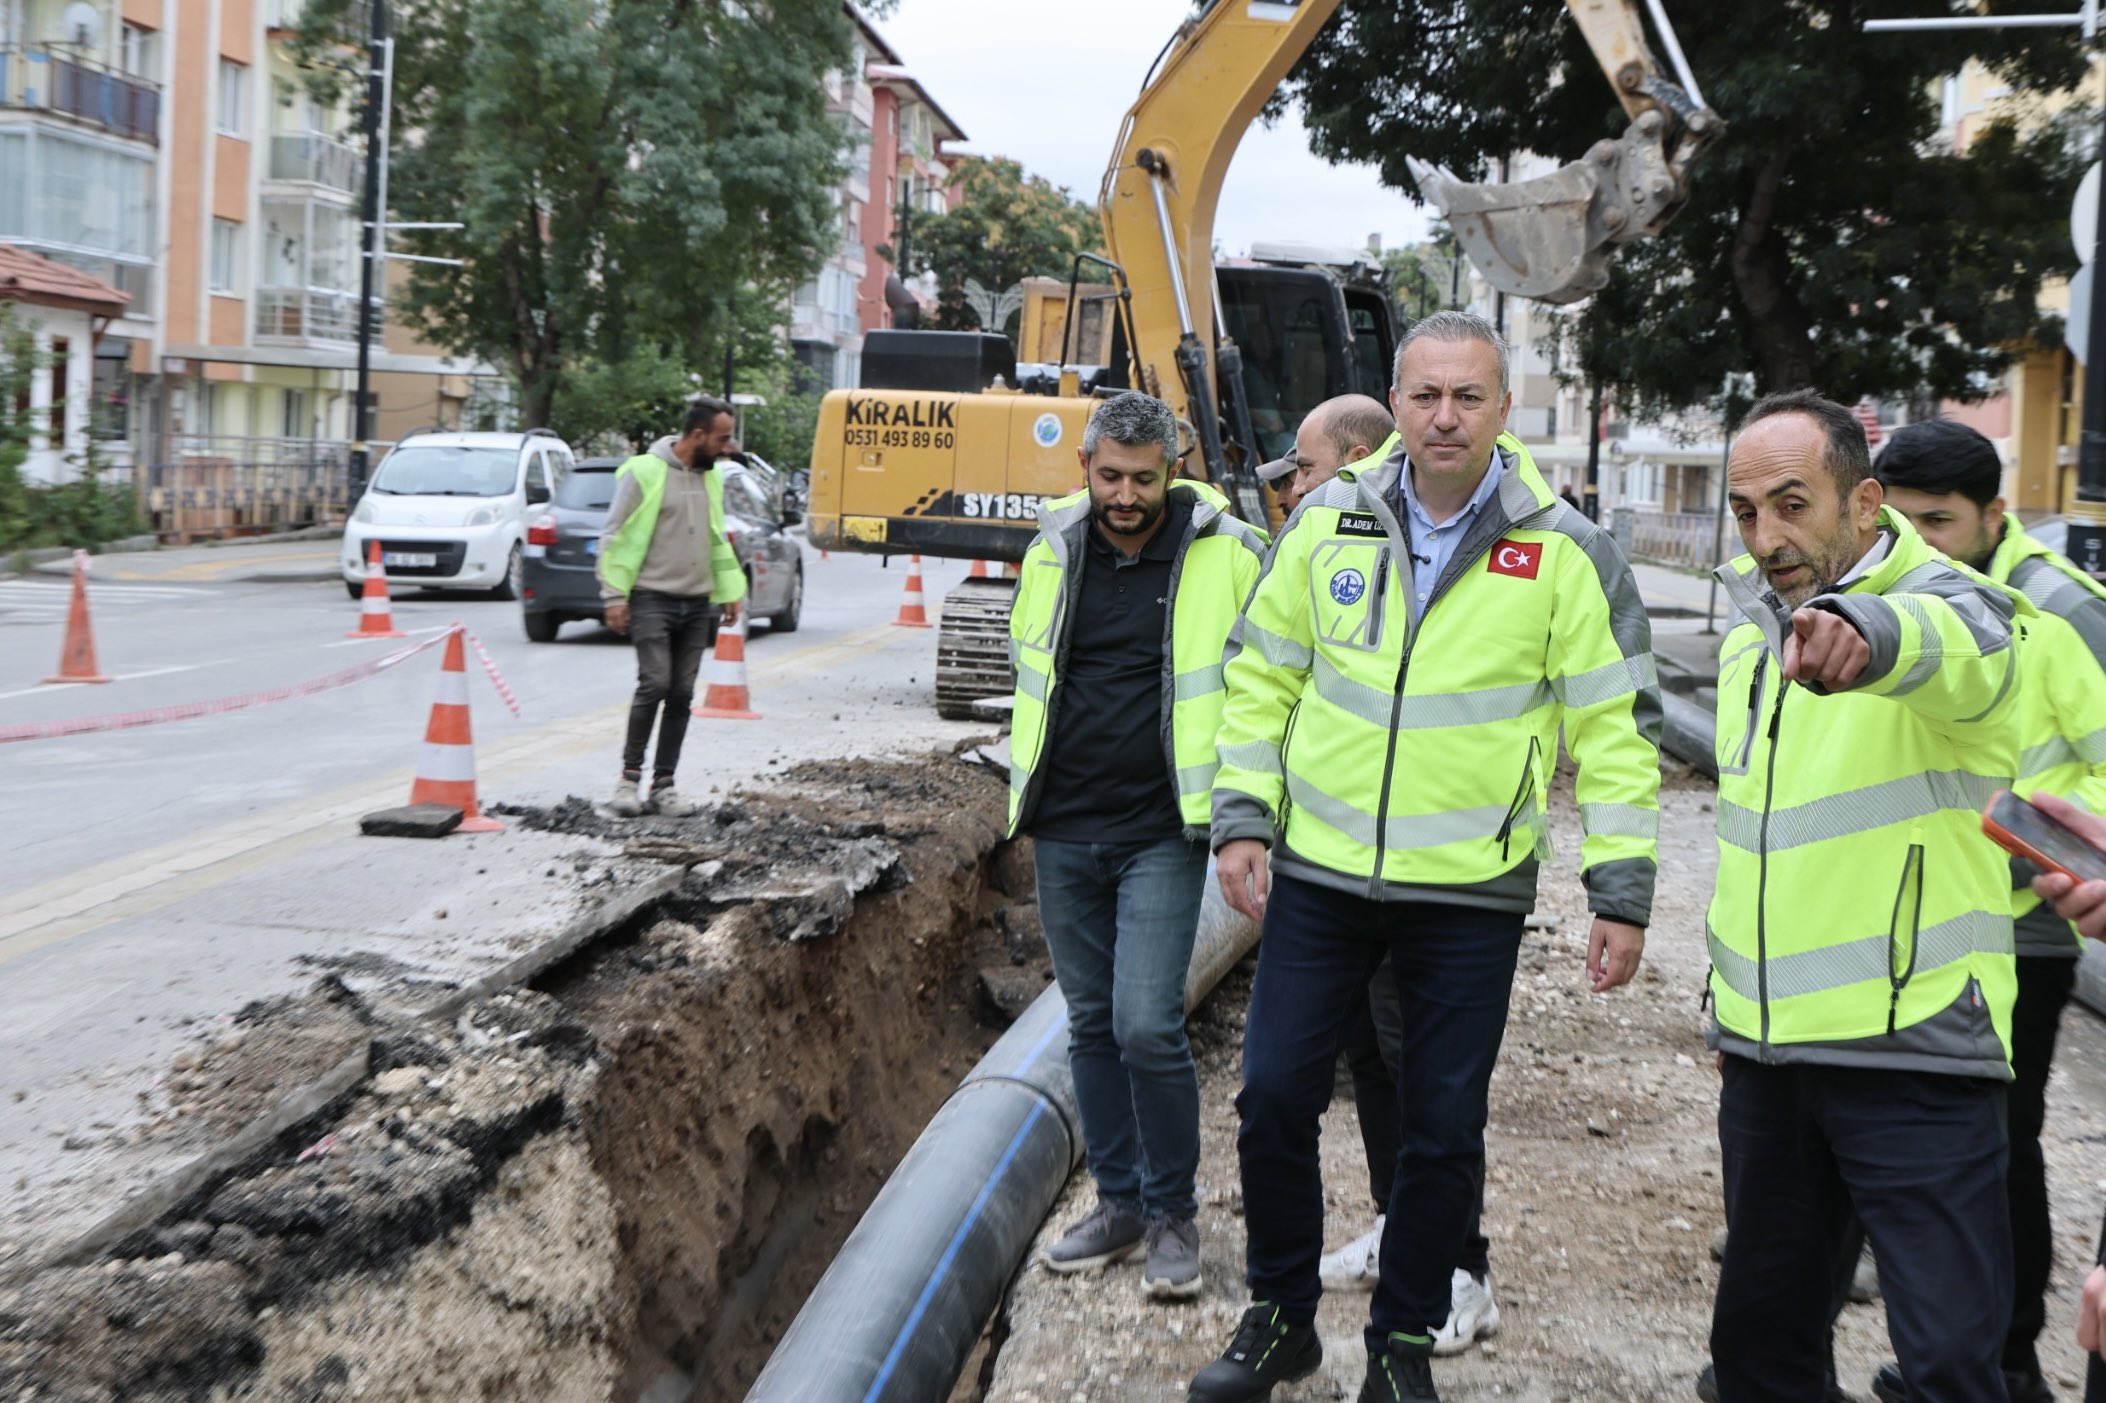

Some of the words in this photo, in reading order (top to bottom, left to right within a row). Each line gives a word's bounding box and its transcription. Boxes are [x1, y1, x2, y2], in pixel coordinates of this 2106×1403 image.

[845, 429, 878, 446] 0531
[882, 430, 908, 447] 493
[912, 431, 930, 448] 89
[934, 432, 954, 449] 60
[963, 493, 1053, 519] SY135
